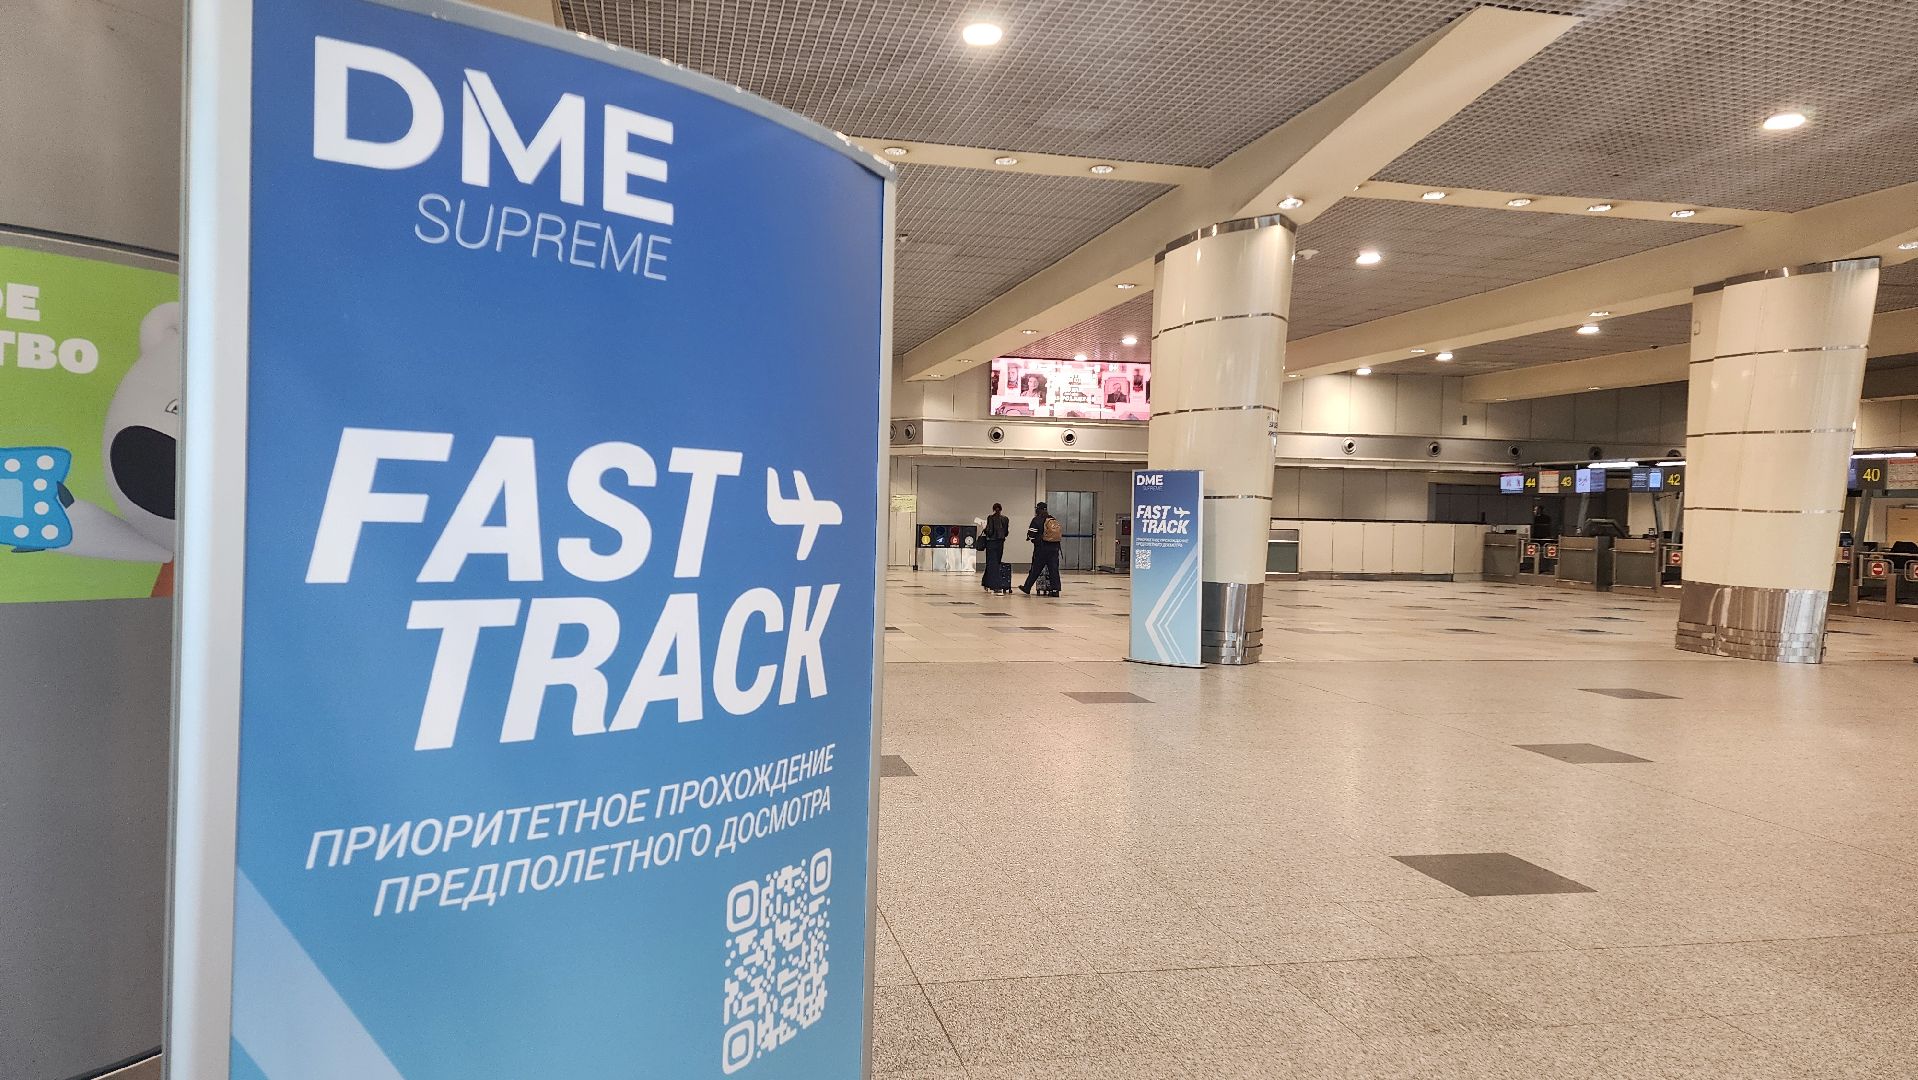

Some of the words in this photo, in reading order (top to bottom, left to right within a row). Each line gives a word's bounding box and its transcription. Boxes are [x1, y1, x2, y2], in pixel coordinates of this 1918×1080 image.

[313, 35, 675, 226] DME
[414, 193, 672, 281] SUPREME
[0, 282, 41, 322] Е
[1136, 474, 1164, 486] DME
[1525, 477, 1536, 488] 44
[1560, 476, 1572, 487] 43
[1667, 473, 1681, 486] 42
[1862, 468, 1881, 482] 40
[304, 427, 744, 584] FAST
[1136, 504, 1171, 519] FAST
[1141, 519, 1190, 535] TRACK
[406, 583, 841, 751] TRACK
[305, 788, 651, 870] ПРИОРИТЕТНОЕ
[655, 743, 836, 819] ПРОХОЖДЕНИЕ
[373, 823, 712, 917] ПРЕДПОЛЕТНОГО
[714, 785, 831, 858] ДОСМОТРА
